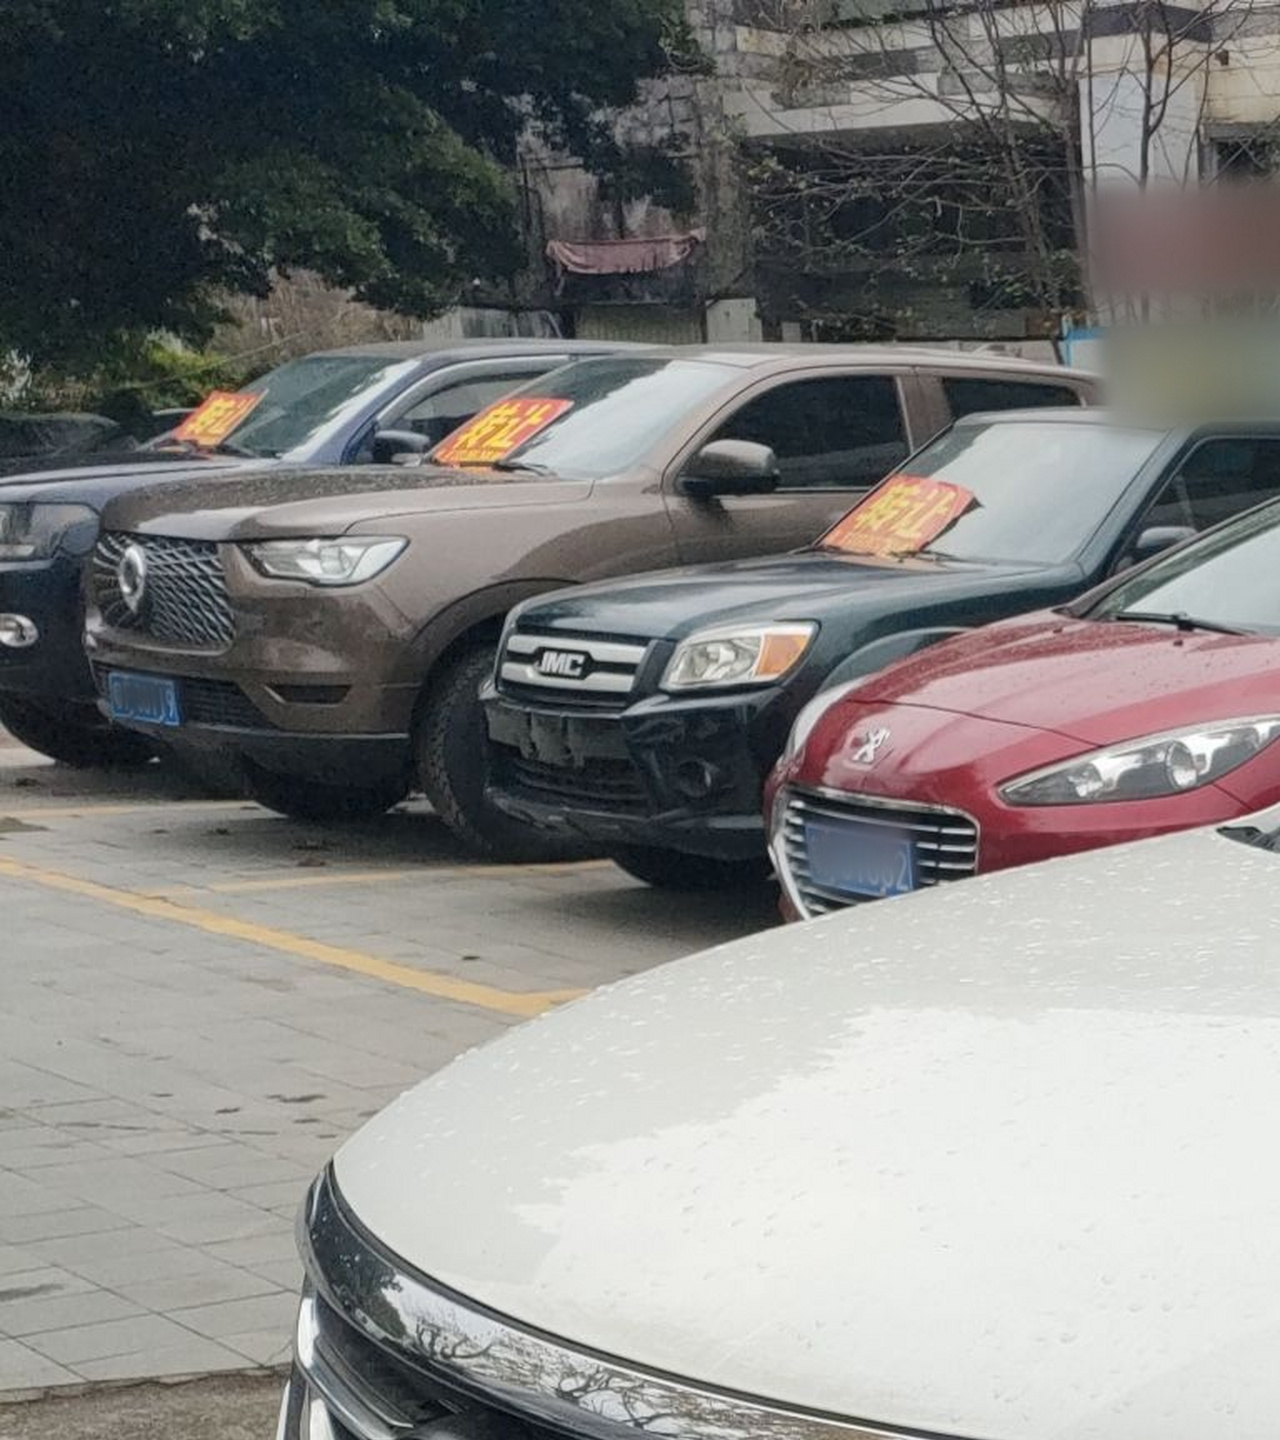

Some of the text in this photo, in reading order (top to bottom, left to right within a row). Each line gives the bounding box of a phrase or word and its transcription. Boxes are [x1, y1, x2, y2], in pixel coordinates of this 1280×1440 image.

[452, 401, 553, 449] 转让
[854, 483, 958, 539] 转让
[539, 650, 586, 677] JMC
